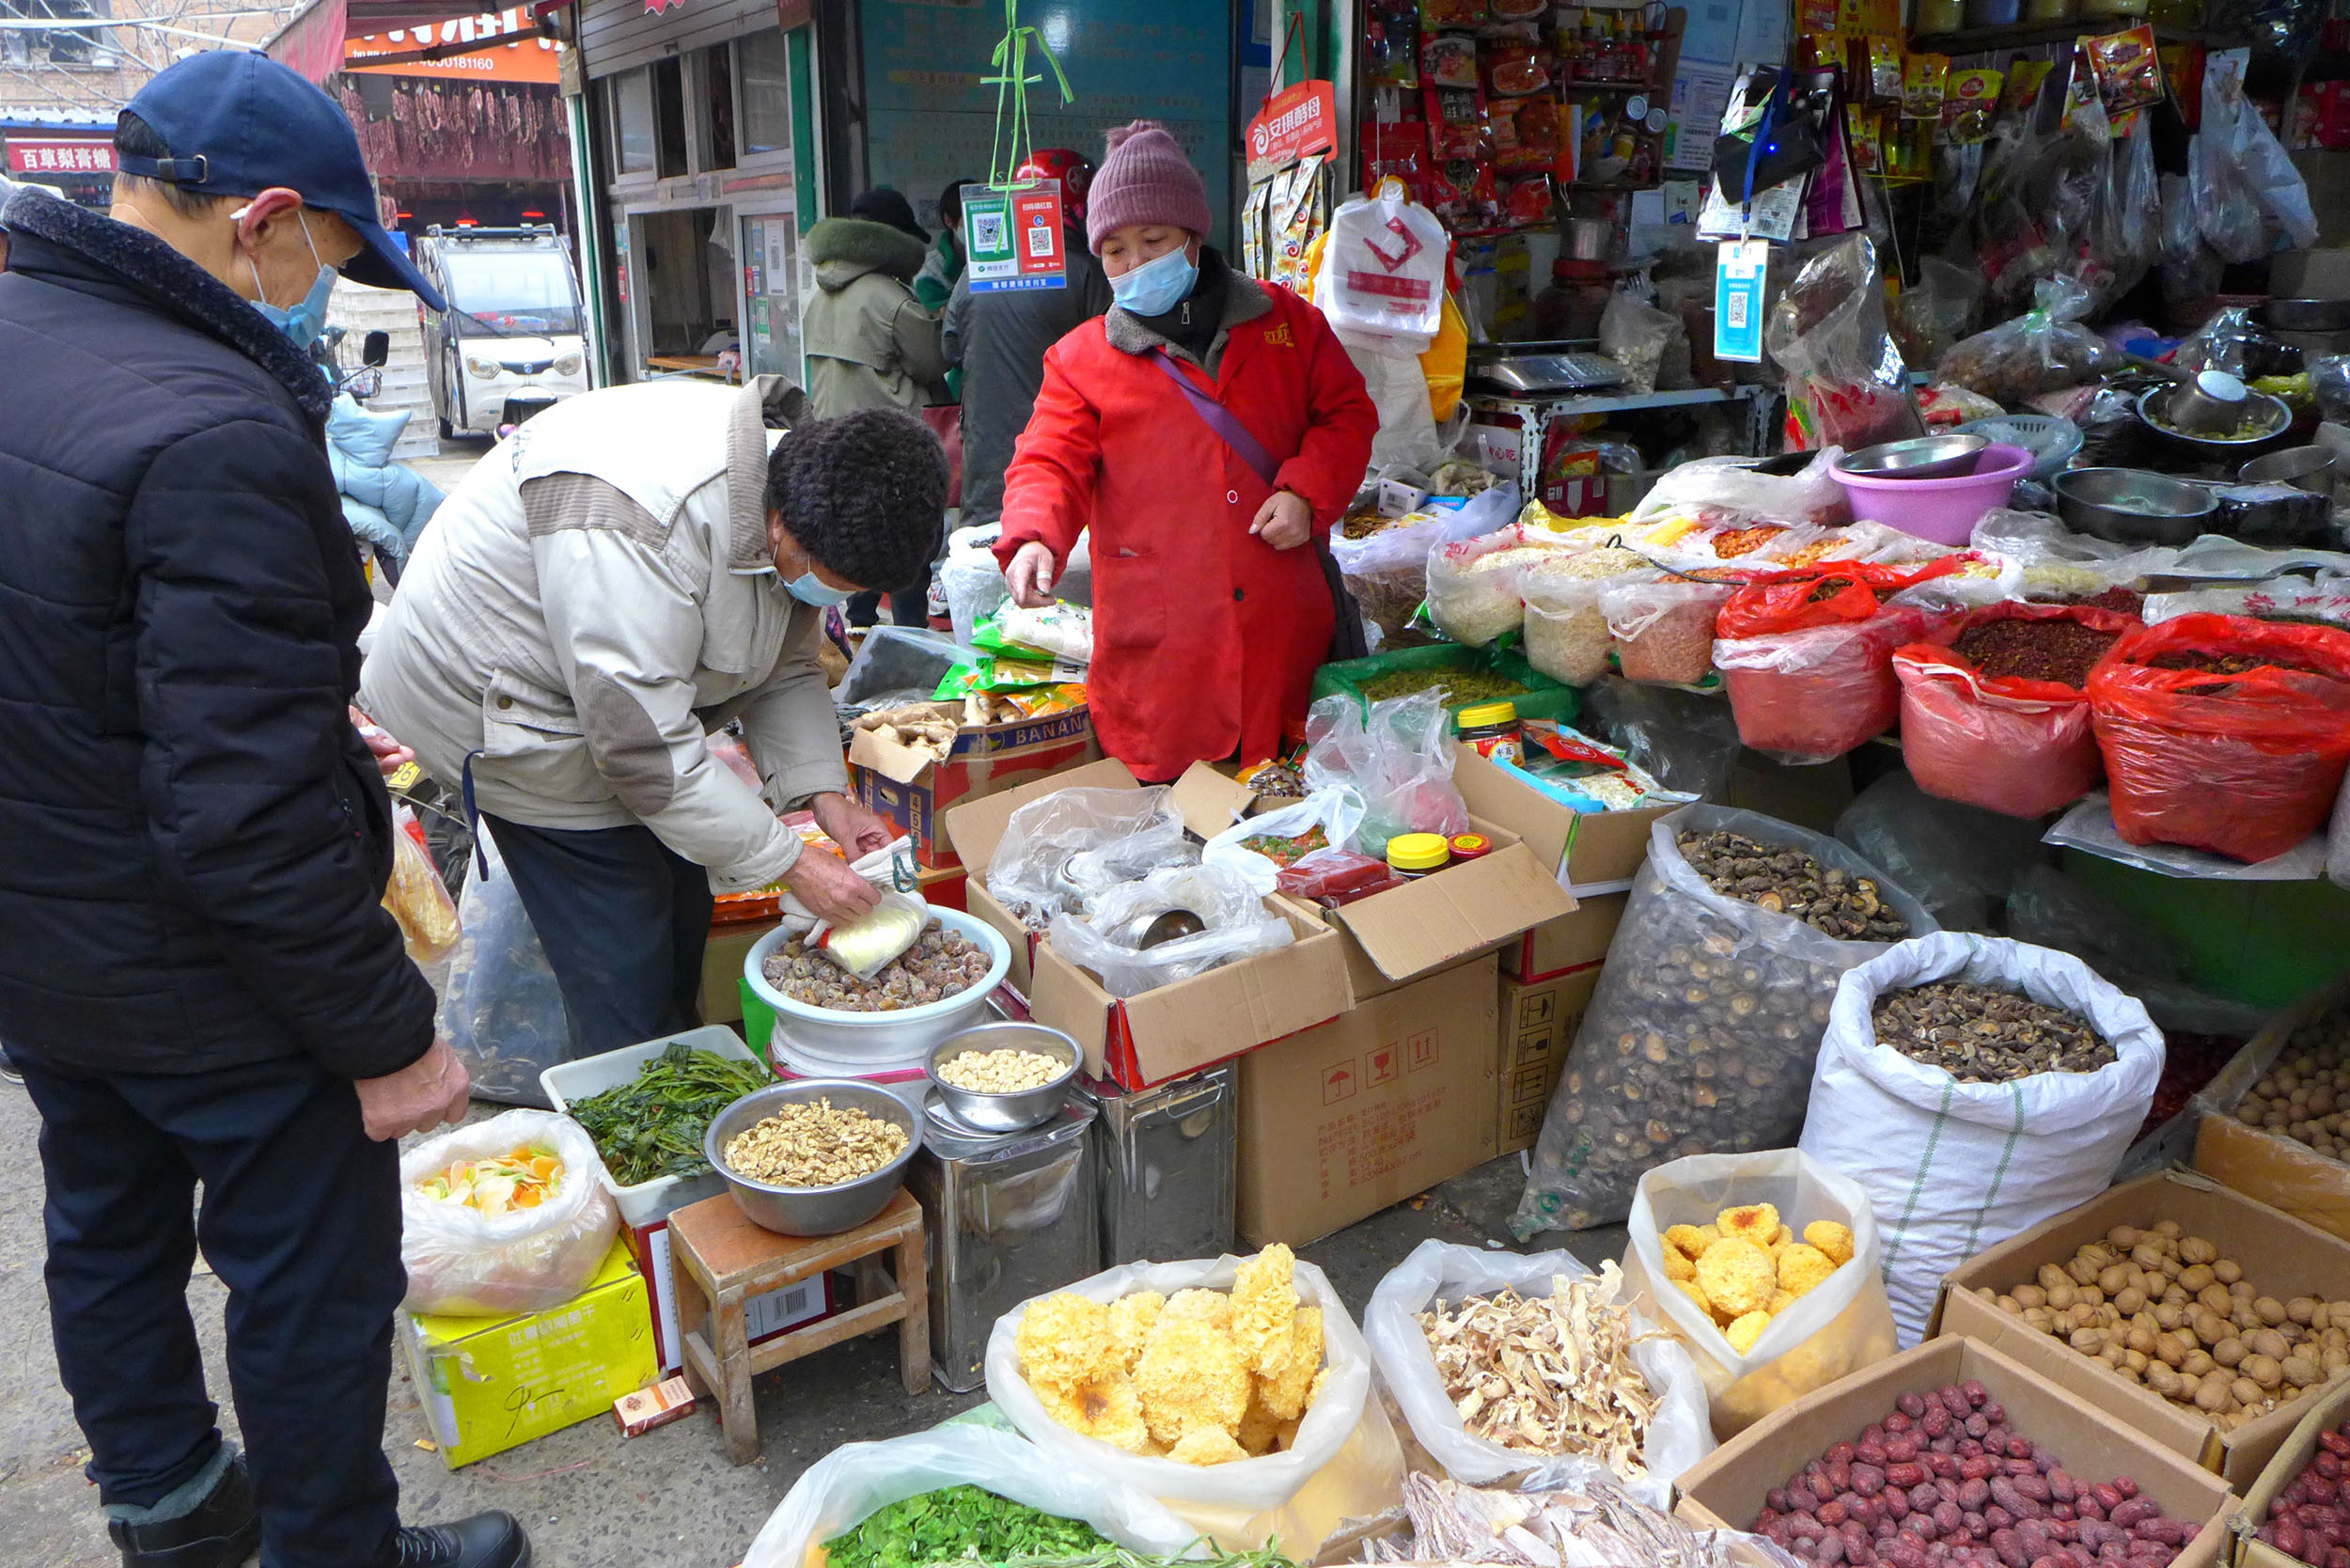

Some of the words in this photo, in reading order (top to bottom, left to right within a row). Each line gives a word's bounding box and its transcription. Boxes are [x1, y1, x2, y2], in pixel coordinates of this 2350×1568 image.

[1269, 95, 1320, 141] 安琪酵母
[20, 148, 111, 169] 百草梨膏糖
[1016, 715, 1082, 745] BANAN
[912, 795, 918, 808] 4
[912, 815, 918, 827] 5
